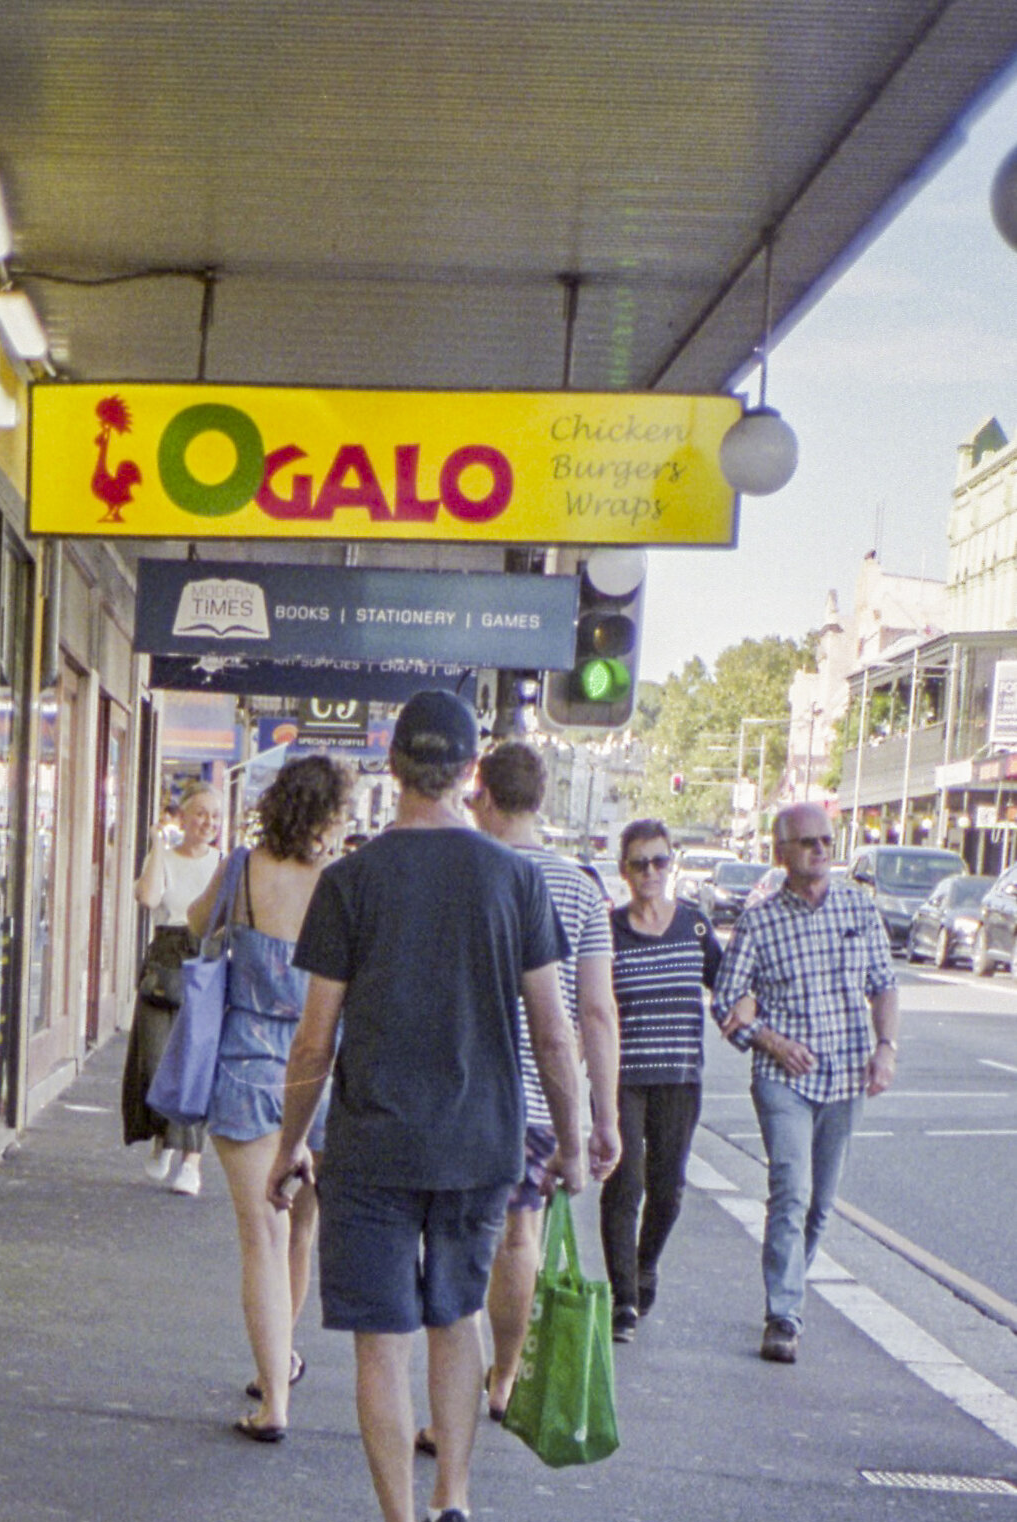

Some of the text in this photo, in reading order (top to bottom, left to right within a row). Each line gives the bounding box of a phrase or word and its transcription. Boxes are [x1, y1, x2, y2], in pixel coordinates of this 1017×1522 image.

[550, 414, 688, 442] Chicken
[157, 402, 513, 523] OGALO
[550, 453, 687, 489] Burgers
[565, 490, 670, 527] Wraps
[191, 584, 255, 599] MODERN
[192, 598, 254, 616] TIMES
[274, 604, 541, 630] BOOKS STATIONERY GAMES
